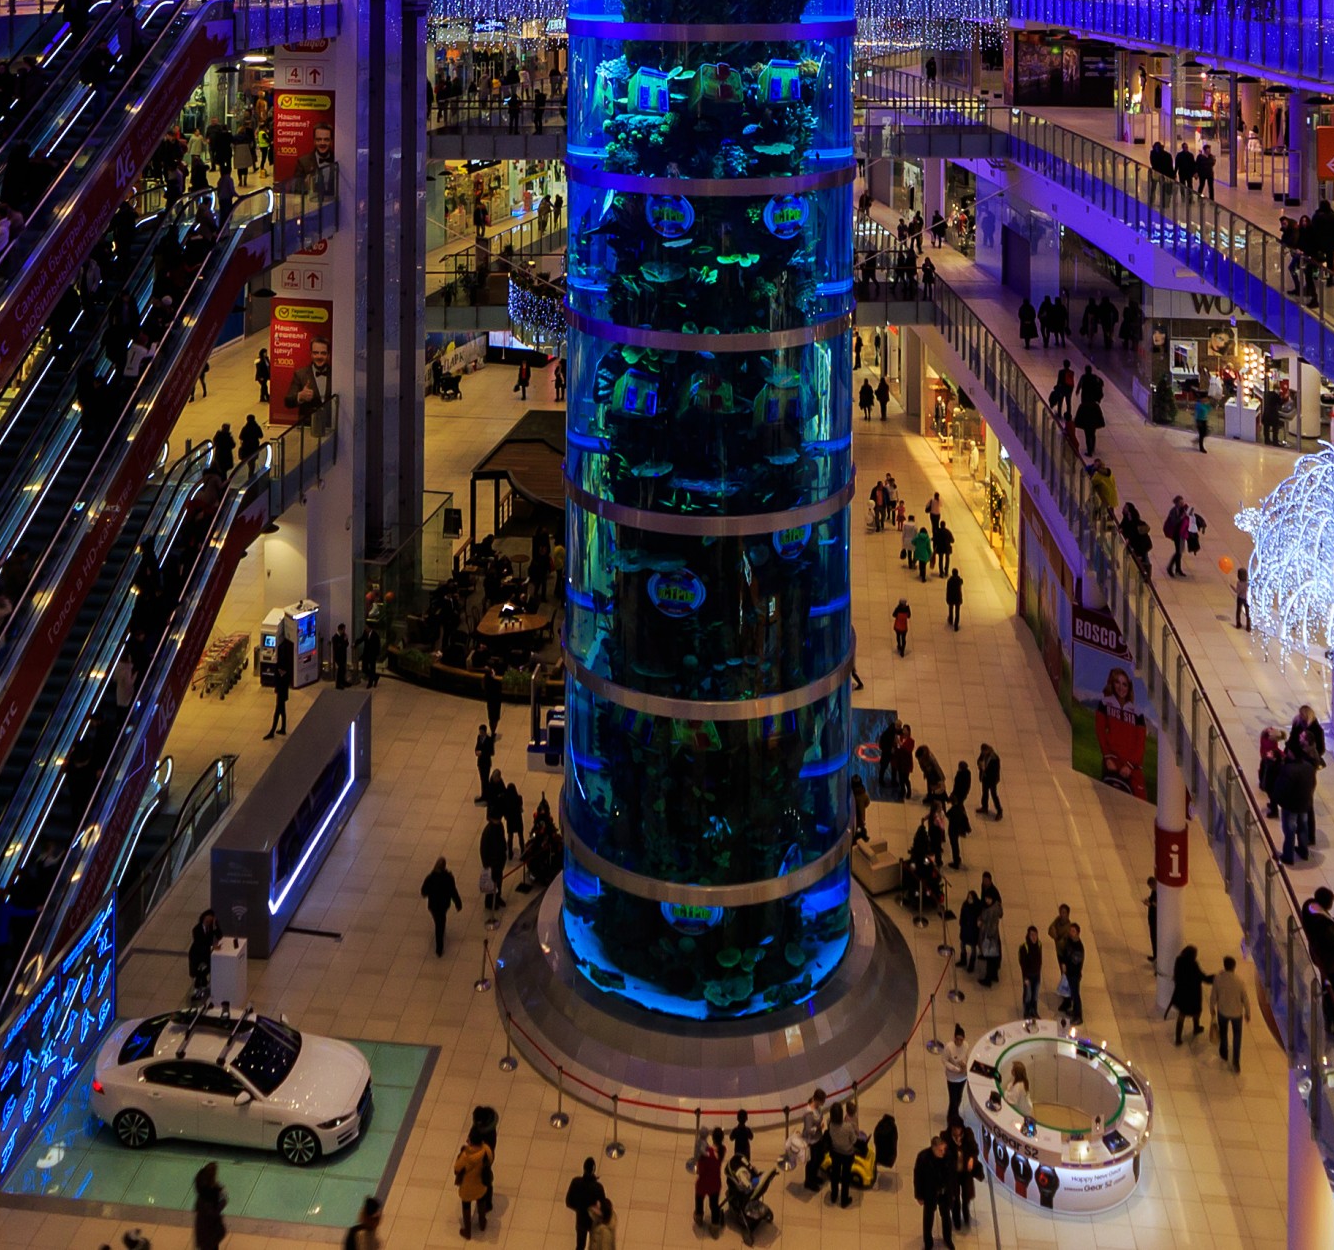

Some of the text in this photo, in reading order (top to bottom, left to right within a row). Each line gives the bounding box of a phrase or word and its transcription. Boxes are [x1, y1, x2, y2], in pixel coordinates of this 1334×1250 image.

[290, 68, 298, 79] 4
[277, 113, 301, 121] Нашли
[115, 154, 135, 189] 4G
[12, 210, 89, 321] Самый быстрый
[17, 197, 113, 340] мобильный интернет
[287, 271, 296, 282] 4
[274, 324, 299, 332] Нашли
[45, 591, 76, 644] Голос
[1075, 617, 1117, 649] BOSCO
[993, 1124, 1039, 1159] Gear S2
[1071, 1174, 1093, 1185] Happy
[1094, 1171, 1109, 1181] New
[1084, 1182, 1104, 1193] Gear
[1105, 1180, 1113, 1188] S2
